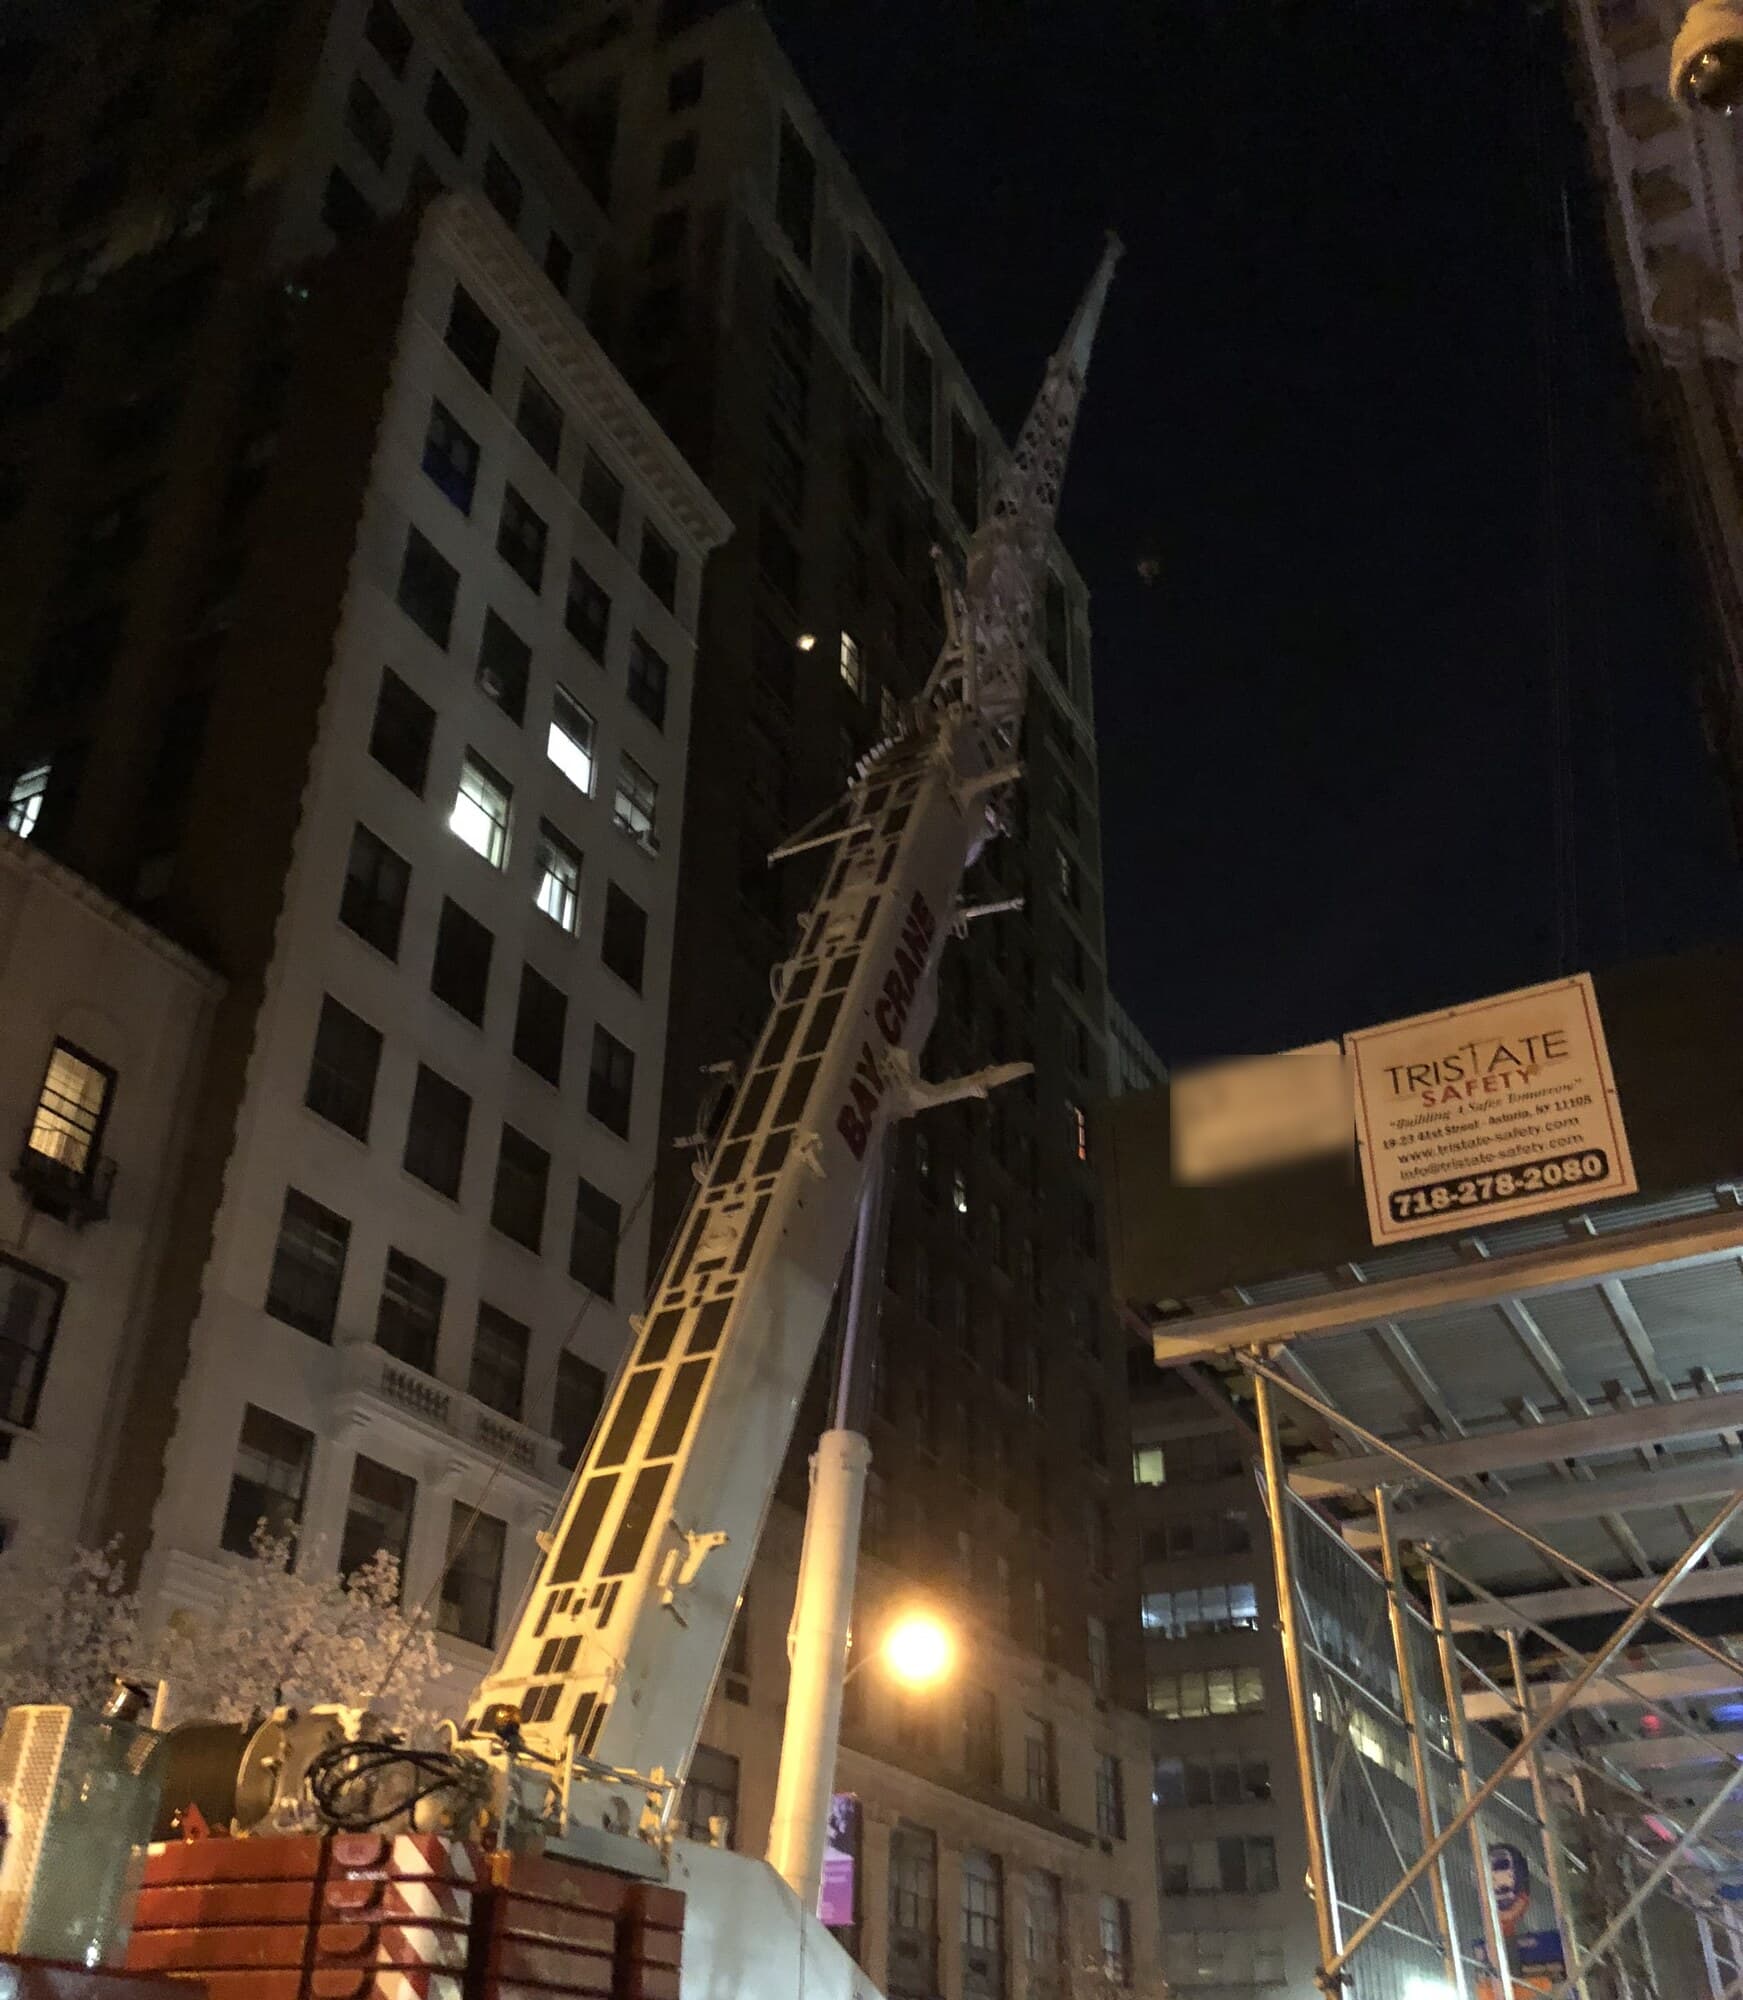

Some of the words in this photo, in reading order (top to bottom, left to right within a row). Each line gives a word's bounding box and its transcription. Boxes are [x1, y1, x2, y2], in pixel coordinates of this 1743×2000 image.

[837, 1041, 886, 1162] BAY
[875, 889, 936, 1046] CRANE
[1383, 1029, 1569, 1095] TRISTATE
[1421, 1068, 1531, 1108] SAFETY
[1397, 1116, 1580, 1165] www.tristate-safety.com
[1444, 1119, 1480, 1137] Street
[1399, 1133, 1585, 1181] info@tristate-safety.com
[1394, 1154, 1602, 1217] 718-278-2080
